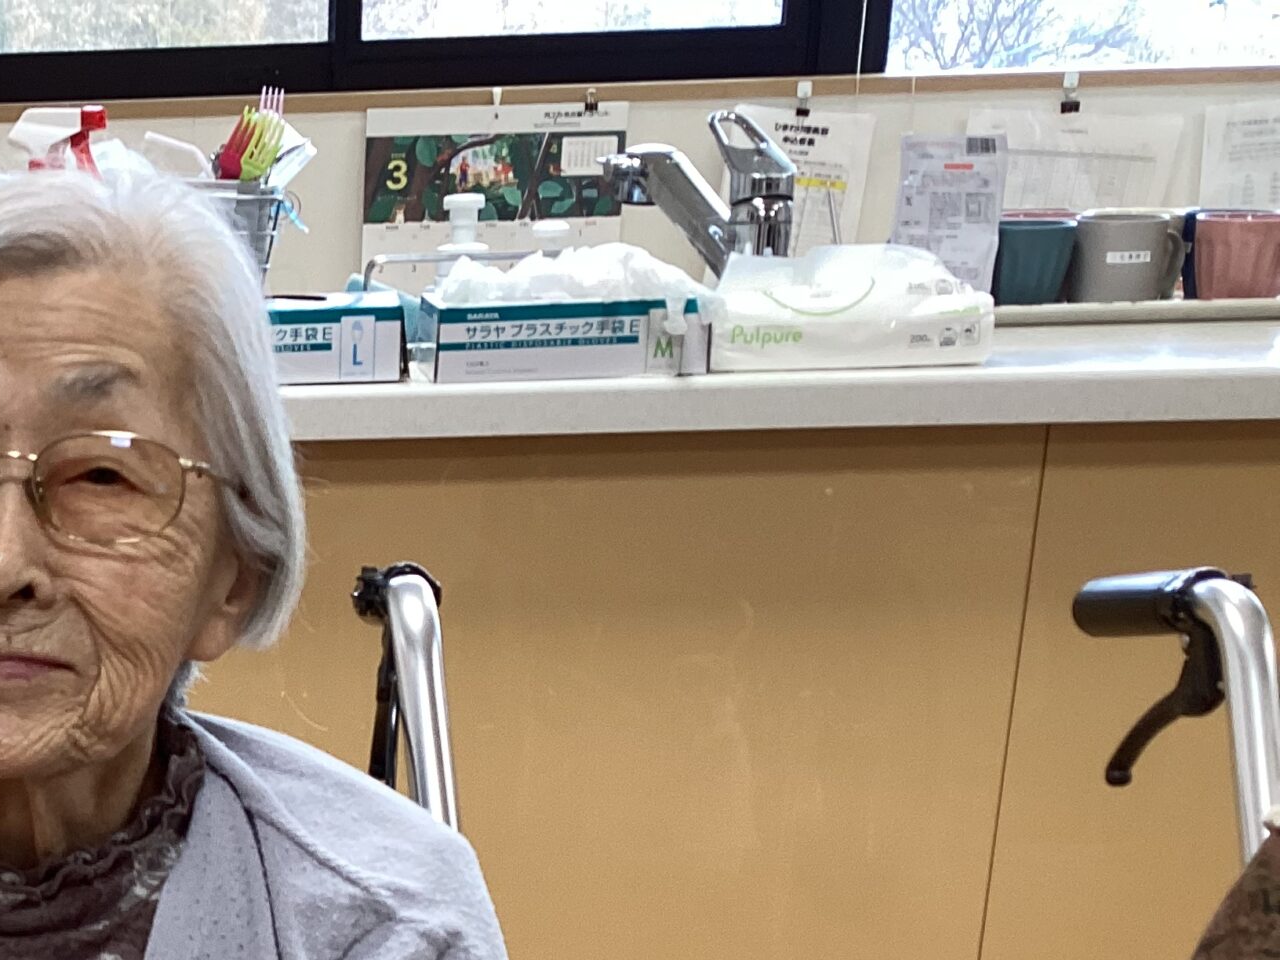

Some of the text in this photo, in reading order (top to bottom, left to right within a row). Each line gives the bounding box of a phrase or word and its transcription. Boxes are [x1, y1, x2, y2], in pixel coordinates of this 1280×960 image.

[385, 158, 409, 191] 3
[275, 326, 333, 342] ク手袋 E
[465, 318, 641, 340] サラヤ プラスチック手袋 E
[730, 325, 804, 350] Pulpure
[351, 342, 364, 366] L
[653, 336, 674, 359] M
